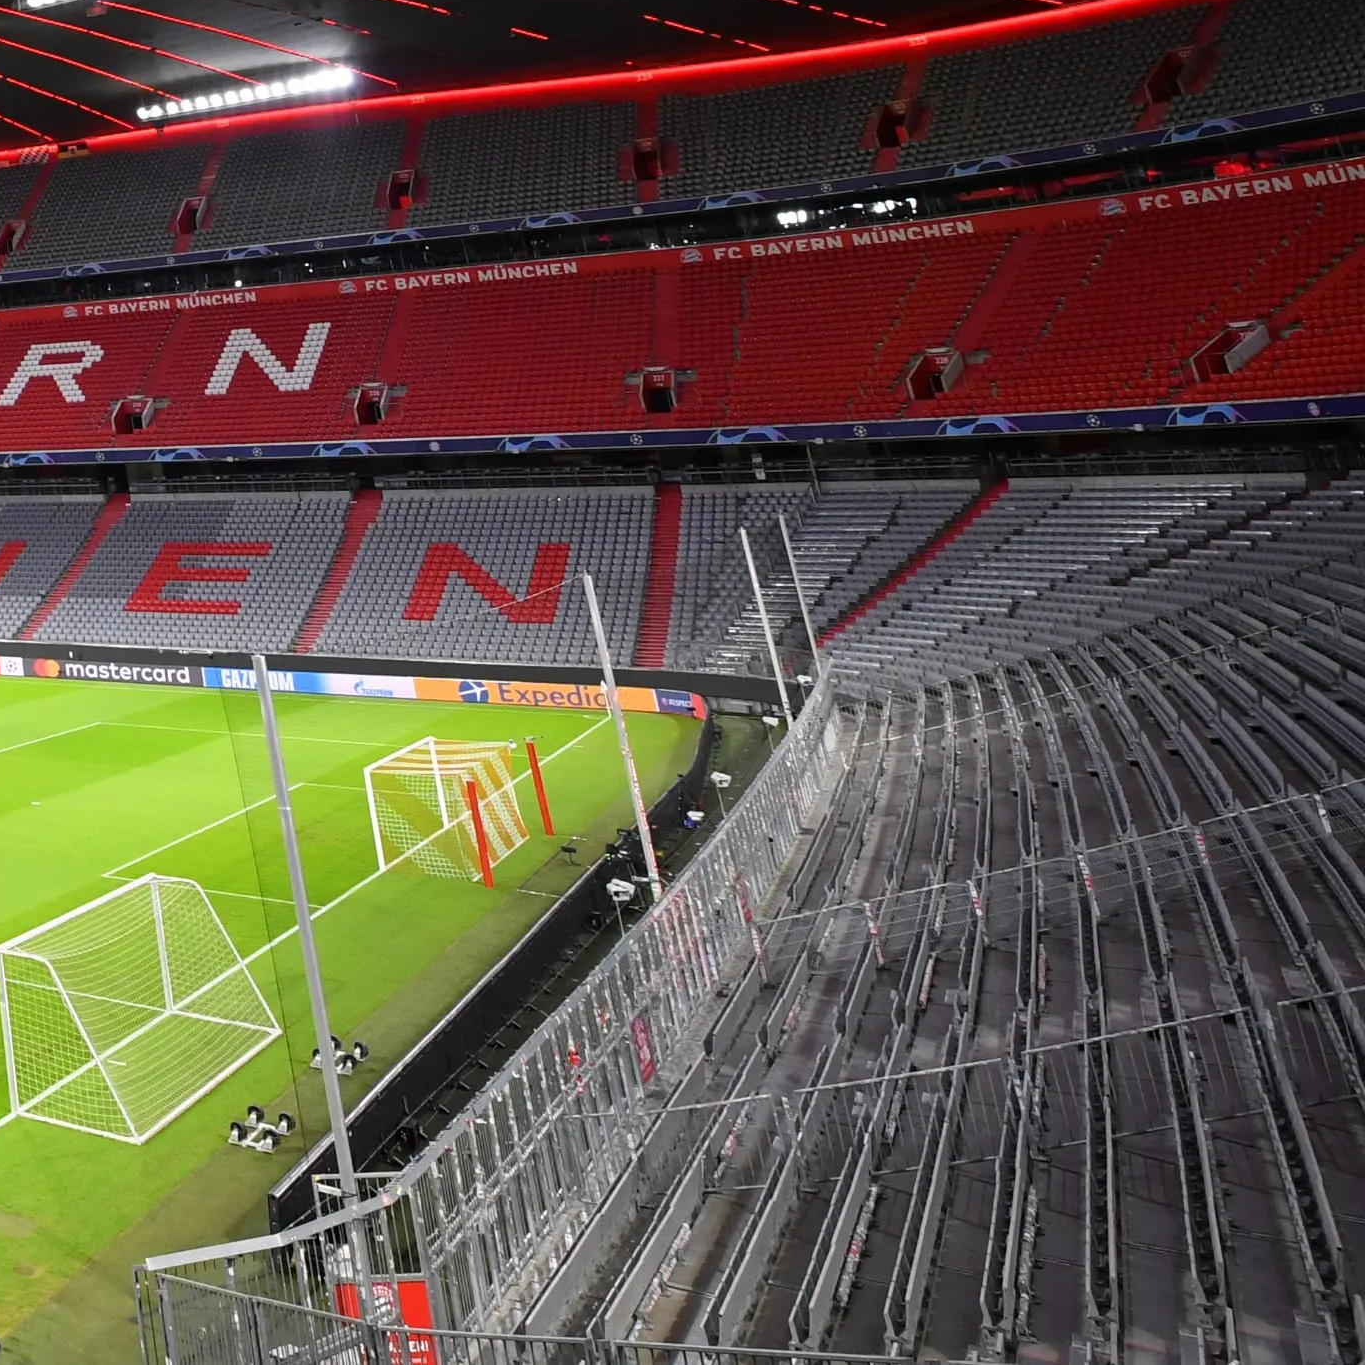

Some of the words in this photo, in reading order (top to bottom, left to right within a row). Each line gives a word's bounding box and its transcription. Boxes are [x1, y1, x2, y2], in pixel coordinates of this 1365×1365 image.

[1138, 194, 1172, 211] FC
[1180, 176, 1294, 206] BAYERN
[713, 246, 743, 261] FC
[750, 235, 843, 258] BAYERN
[852, 220, 974, 246] MÜNCHEN
[365, 279, 388, 291] FC
[394, 272, 471, 290] BAYERN
[477, 262, 578, 283] MÜNCHEN
[84, 305, 103, 316] FC
[109, 299, 170, 314] BAYERN
[176, 291, 256, 309] MÜNCHEN
[65, 663, 191, 684] mastercard
[221, 669, 294, 691] GAZPOM
